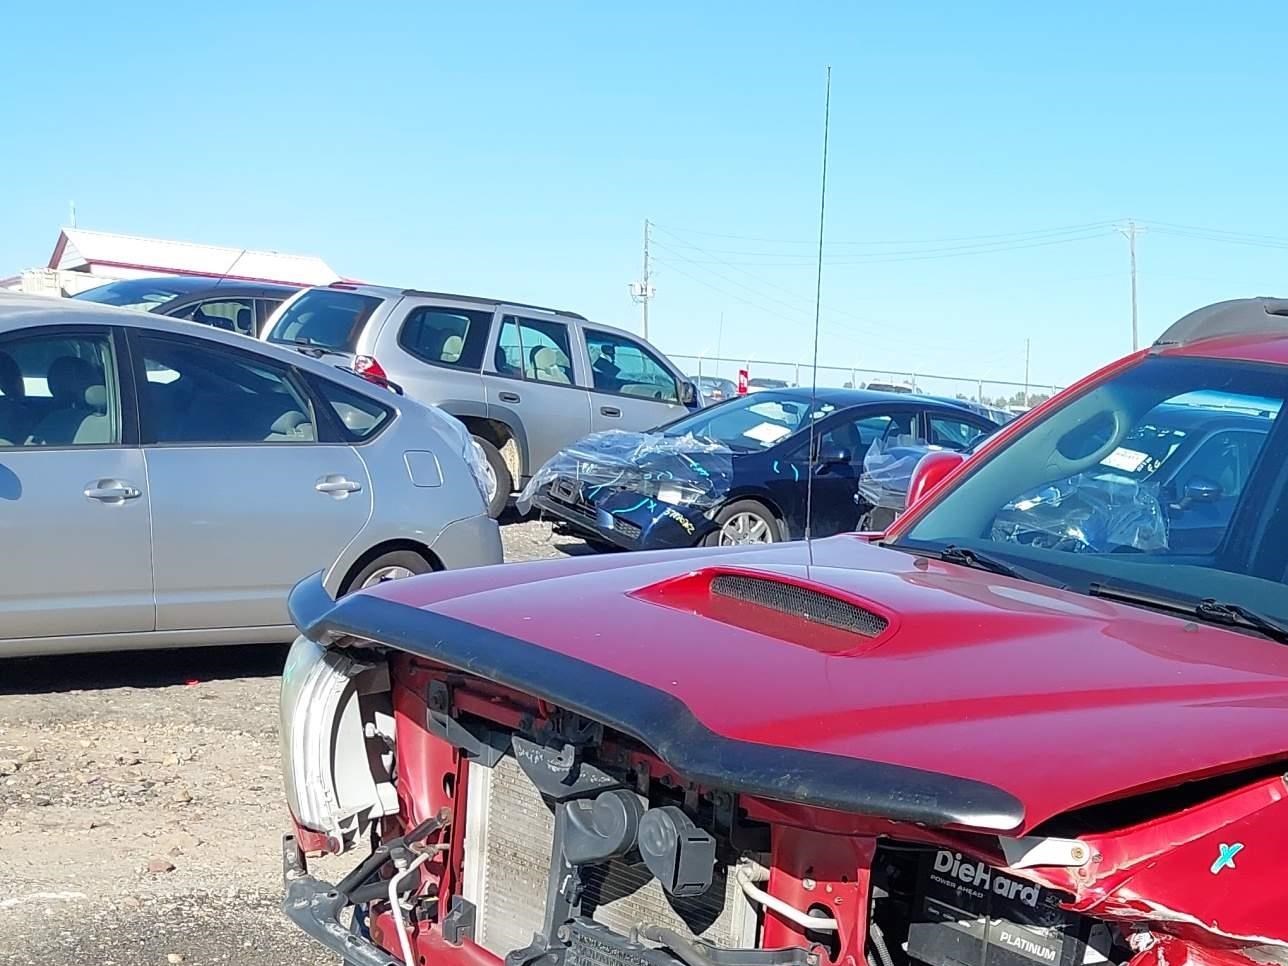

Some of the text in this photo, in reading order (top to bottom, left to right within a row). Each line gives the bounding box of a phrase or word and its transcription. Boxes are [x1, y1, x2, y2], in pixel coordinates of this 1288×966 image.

[930, 874, 984, 899] POWER AHEAD
[933, 850, 1041, 908] DieHard
[1000, 931, 1056, 961] PLATINUM
